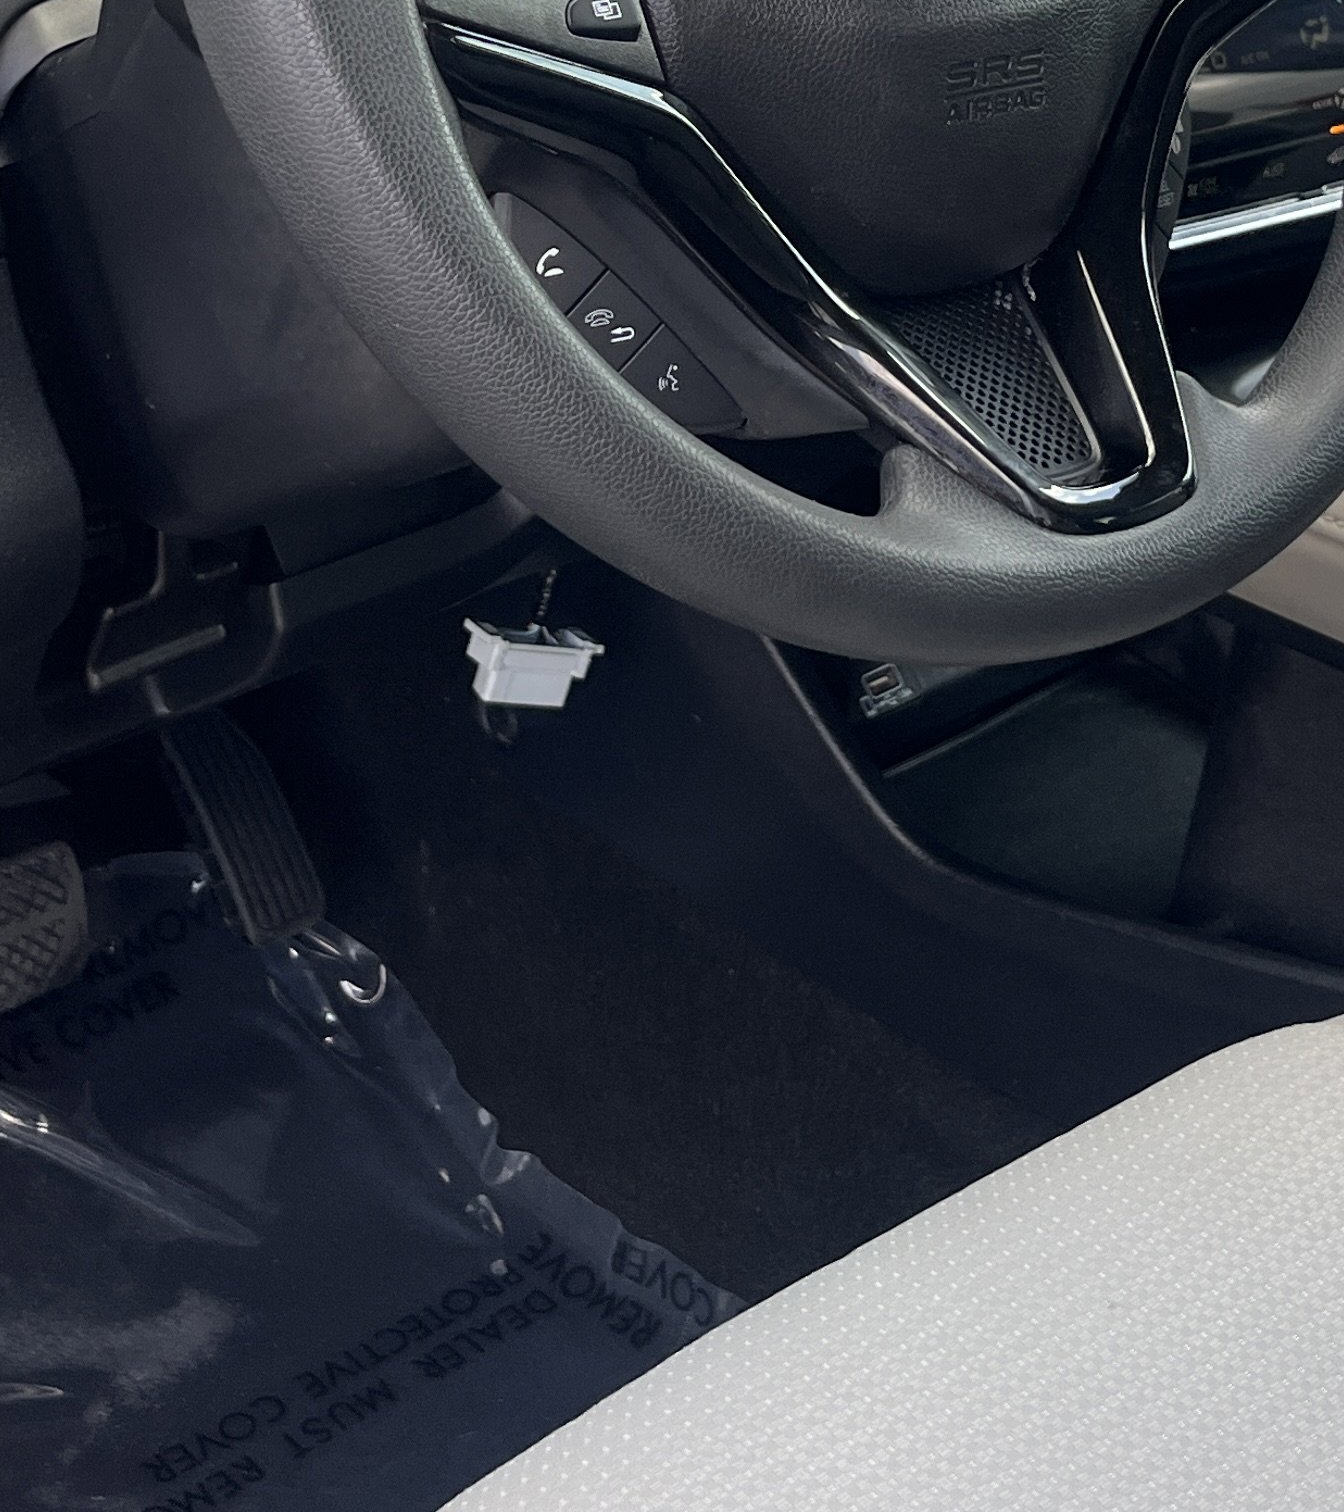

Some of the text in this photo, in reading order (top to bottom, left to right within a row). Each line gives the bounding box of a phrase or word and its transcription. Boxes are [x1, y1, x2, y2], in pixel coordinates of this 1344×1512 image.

[945, 47, 1046, 92] SRS
[56, 969, 181, 1049] COVER
[515, 1231, 663, 1351] REMOVE
[610, 1234, 714, 1326] COVER
[141, 1263, 526, 1483] PROTECTIVE COVER
[142, 1287, 558, 1512] DEALER MUST REM
